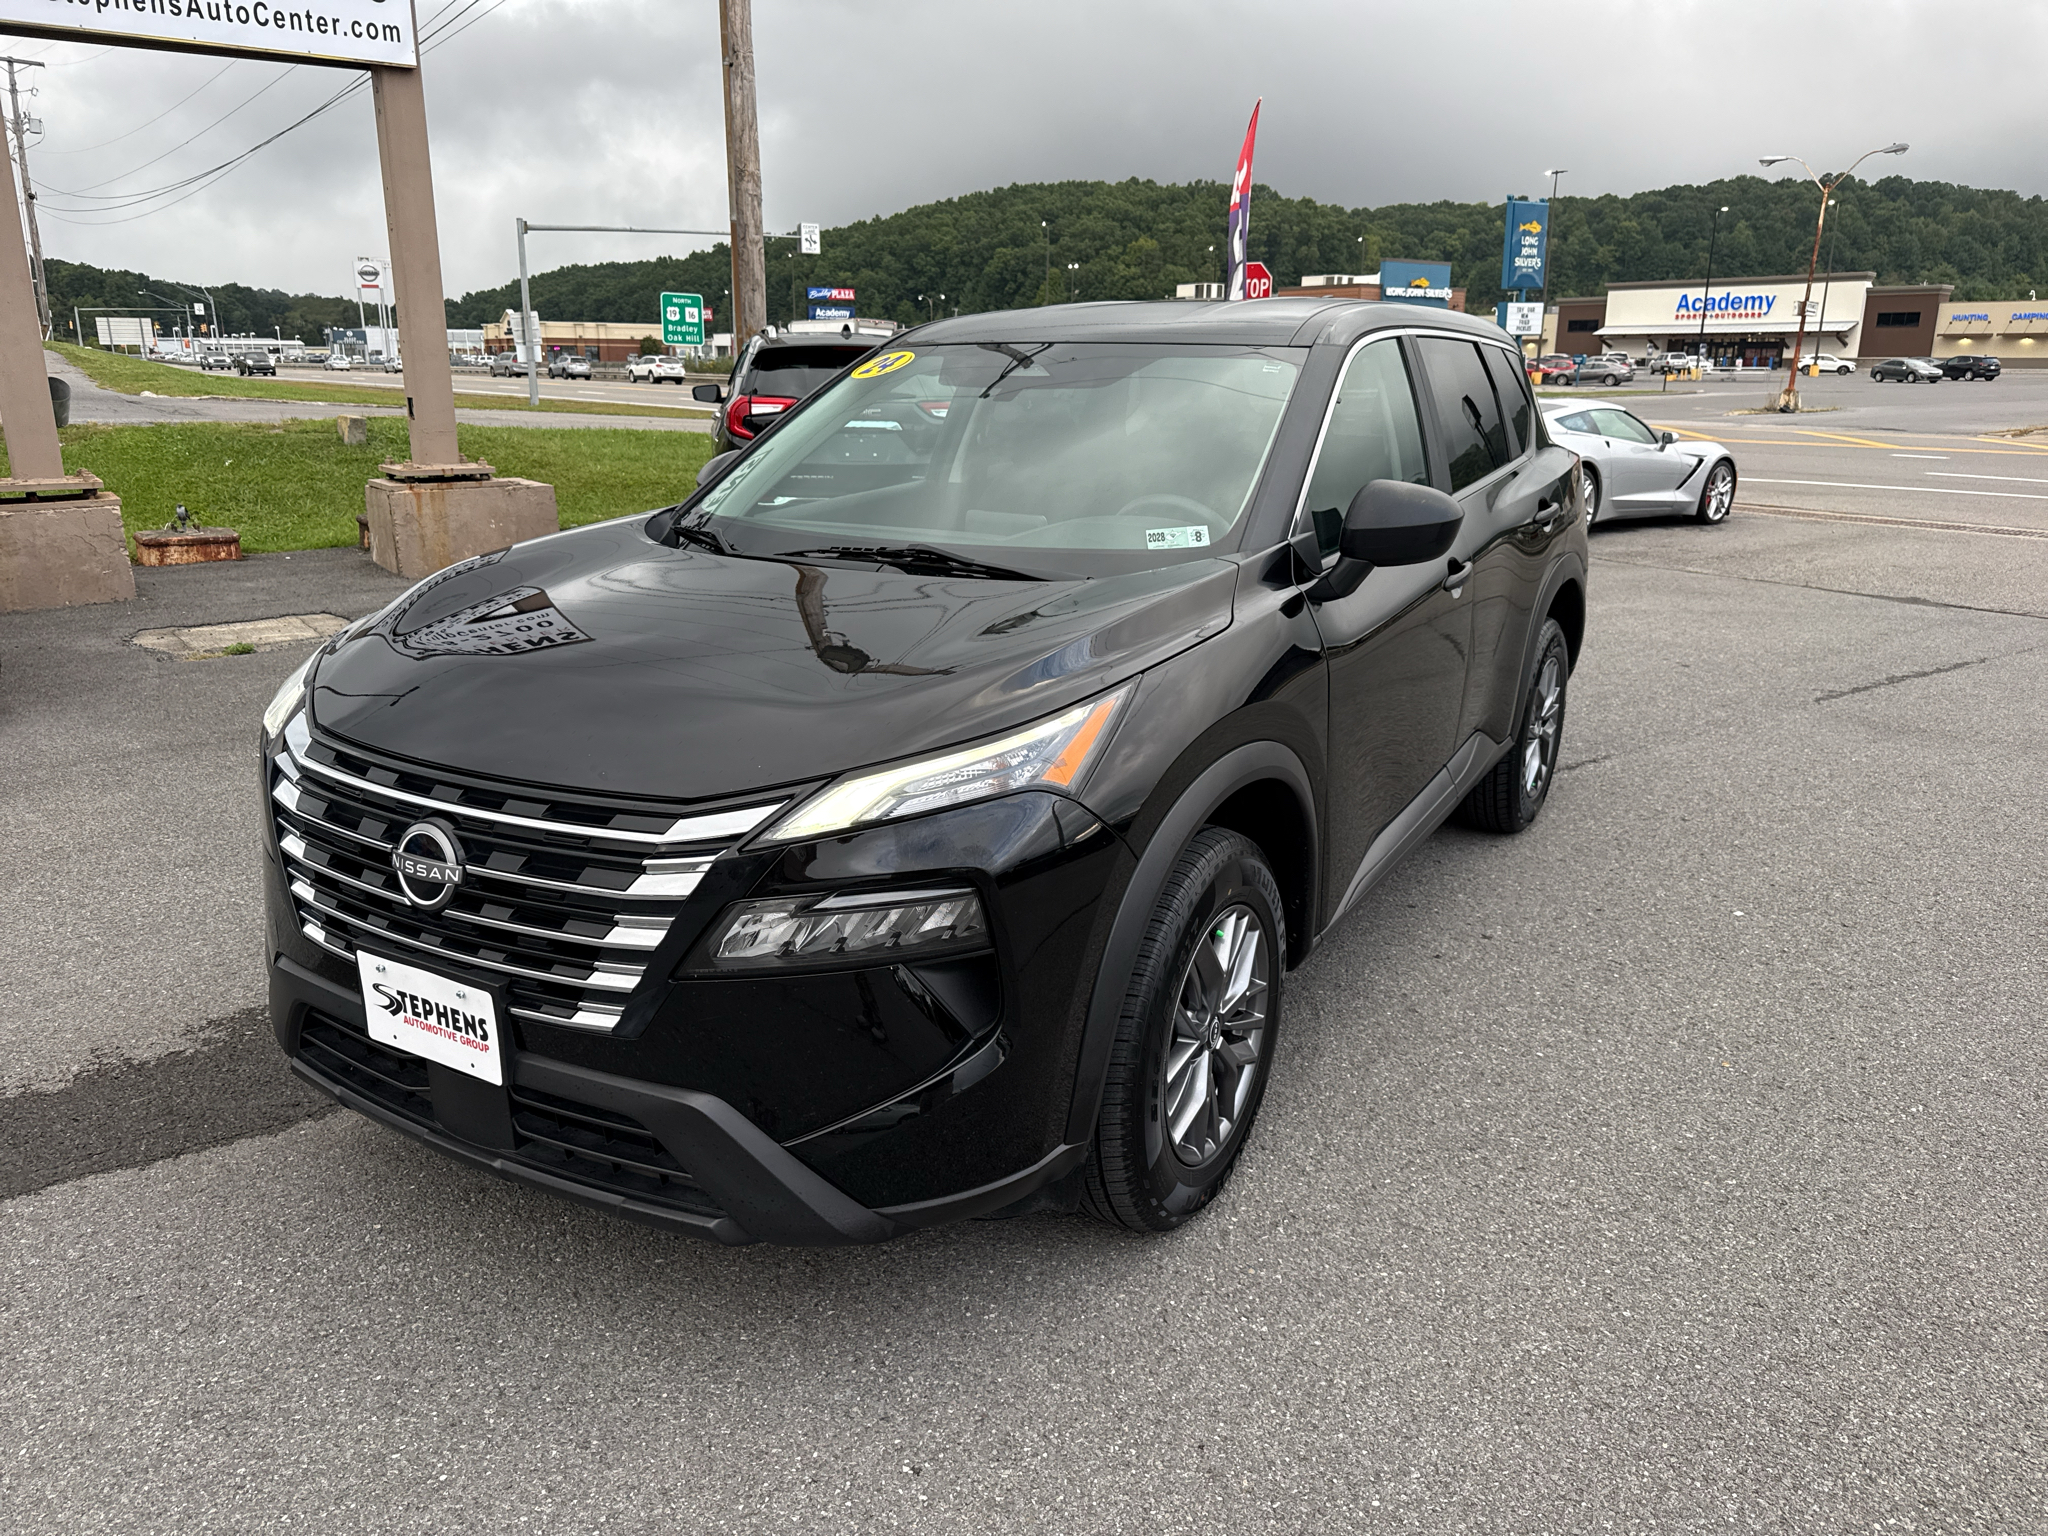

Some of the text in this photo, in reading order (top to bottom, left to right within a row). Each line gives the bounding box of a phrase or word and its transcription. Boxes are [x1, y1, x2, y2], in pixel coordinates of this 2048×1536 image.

[1521, 235, 1539, 246] LONG
[1520, 246, 1538, 256] JOHN
[1514, 256, 1541, 270] SILVER'S
[1246, 277, 1270, 298] TOP
[831, 289, 855, 299] PLAZA
[1386, 287, 1453, 301] LONG JOHN SILVER'S
[1676, 292, 1777, 315] Academy
[669, 309, 678, 318] 19
[687, 310, 696, 320] 16
[815, 307, 850, 318] Academy
[1952, 312, 2048, 321] HUNTING CAMPING
[668, 324, 698, 334] Bradley
[667, 334, 700, 343] Oak Hill
[1147, 532, 1166, 543] 2028
[1194, 531, 1203, 543] 8
[392, 853, 459, 882] NISSAN
[372, 982, 489, 1042] STEPHENS
[403, 1015, 490, 1053] AUTOMOTIVE GROUP
